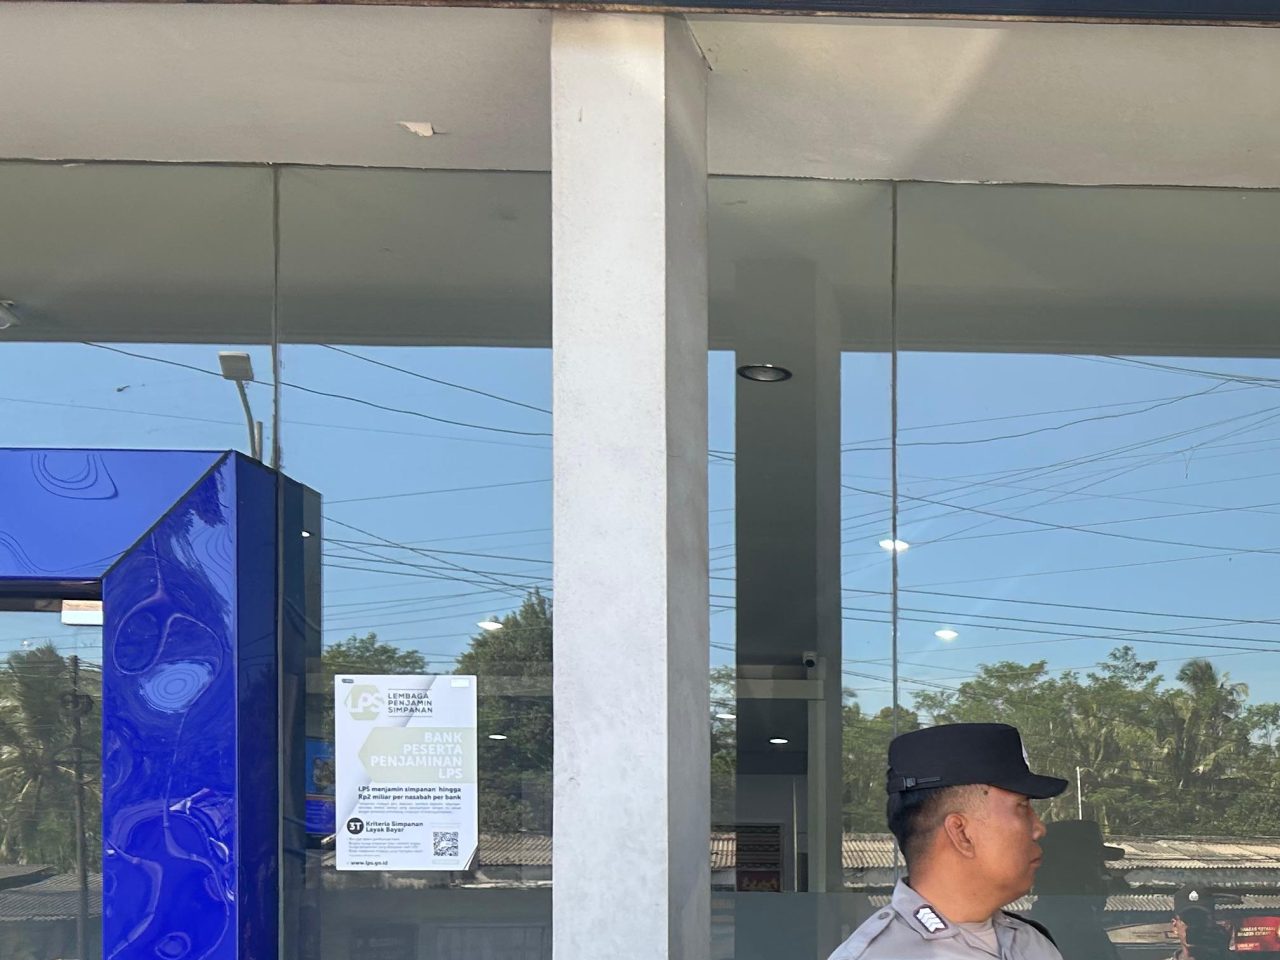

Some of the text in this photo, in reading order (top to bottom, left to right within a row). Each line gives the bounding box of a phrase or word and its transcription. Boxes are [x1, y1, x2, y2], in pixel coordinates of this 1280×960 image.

[425, 732, 463, 743] BANK
[403, 744, 463, 755] PESERTA
[370, 755, 463, 767] PENJAMINAN
[438, 768, 463, 779] LPS
[349, 821, 363, 831] 3T
